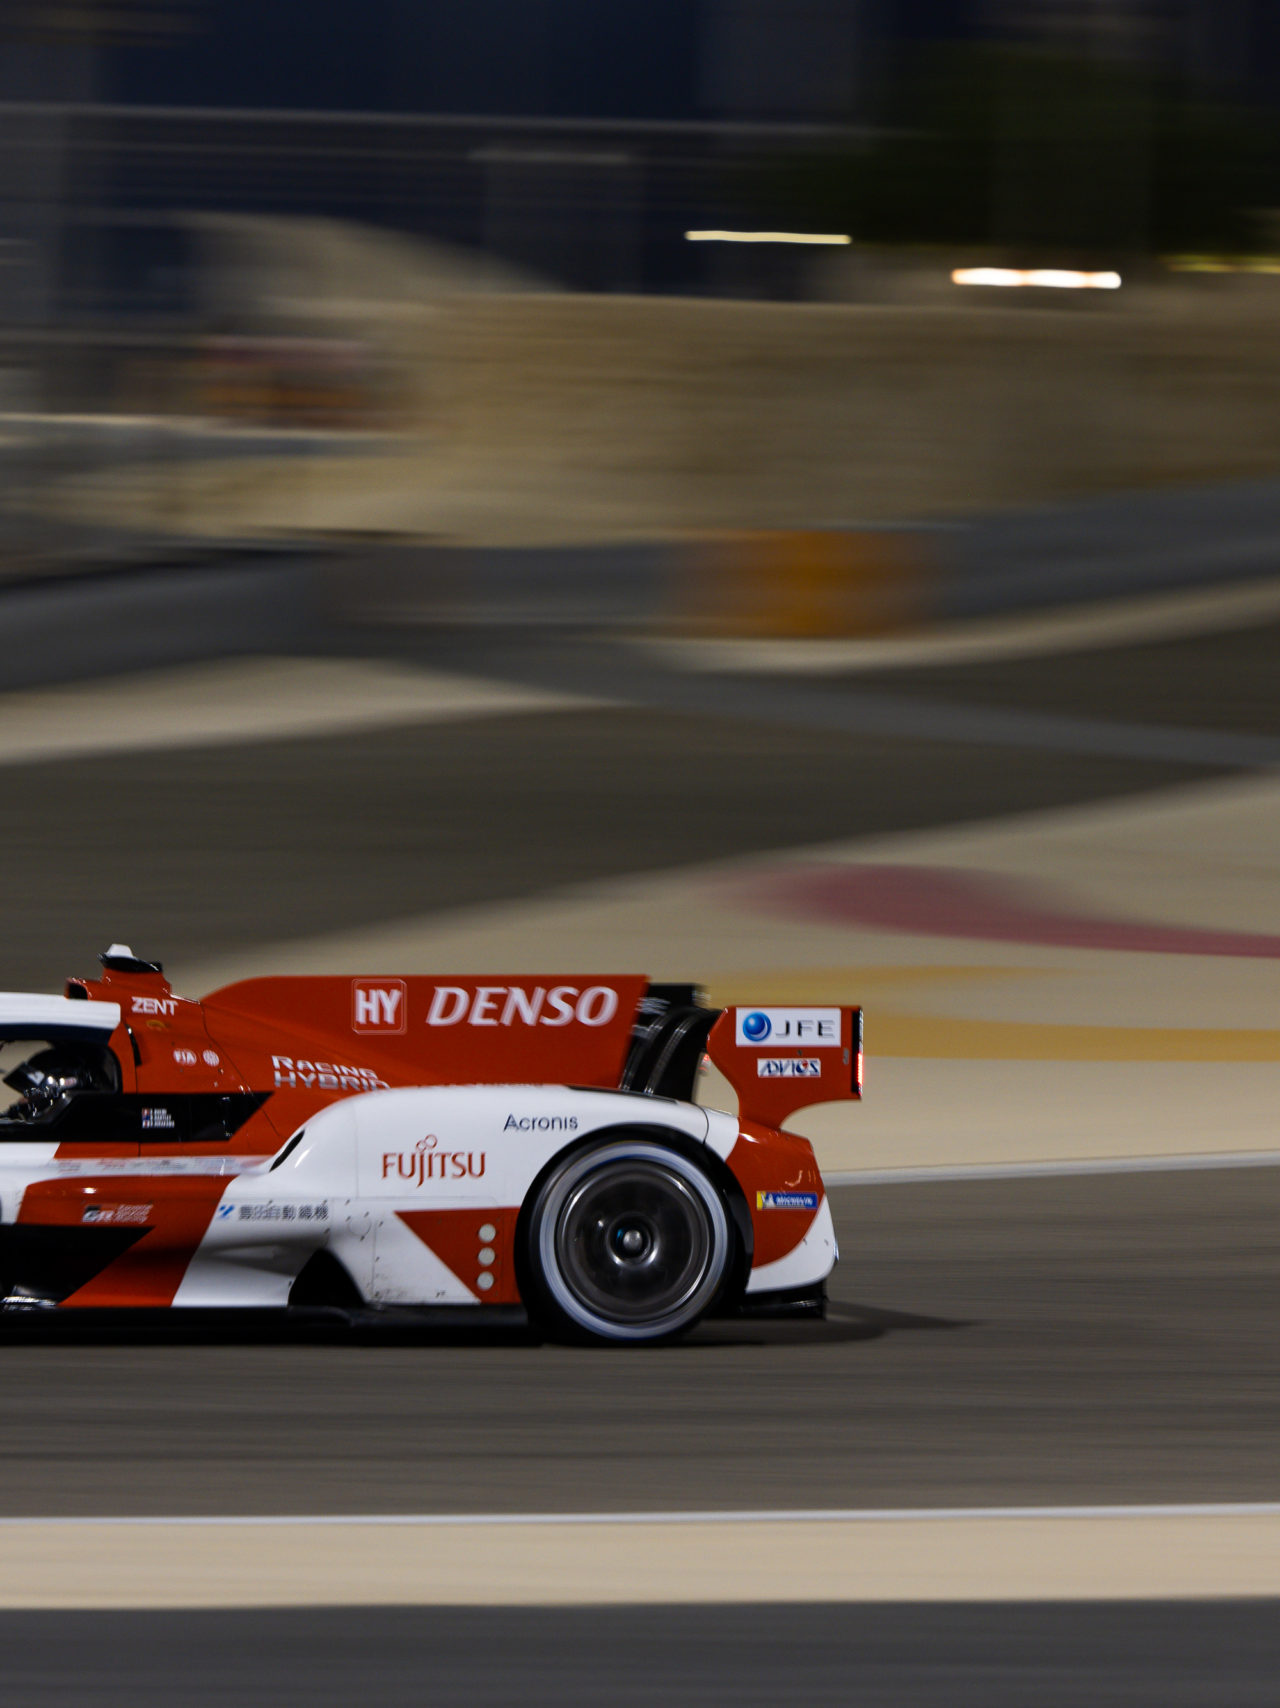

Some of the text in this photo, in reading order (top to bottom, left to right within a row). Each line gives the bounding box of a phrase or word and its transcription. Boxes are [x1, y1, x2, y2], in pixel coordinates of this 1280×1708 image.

[131, 996, 178, 1015] ZENT
[355, 988, 402, 1025] HY
[426, 986, 619, 1027] DENSO
[775, 1020, 835, 1038] JFE
[174, 1050, 196, 1065] FIA
[271, 1055, 379, 1080] RACING
[760, 1060, 820, 1077] ADVICS
[503, 1113, 579, 1132] Acronis
[381, 1150, 486, 1188] FUJITSU
